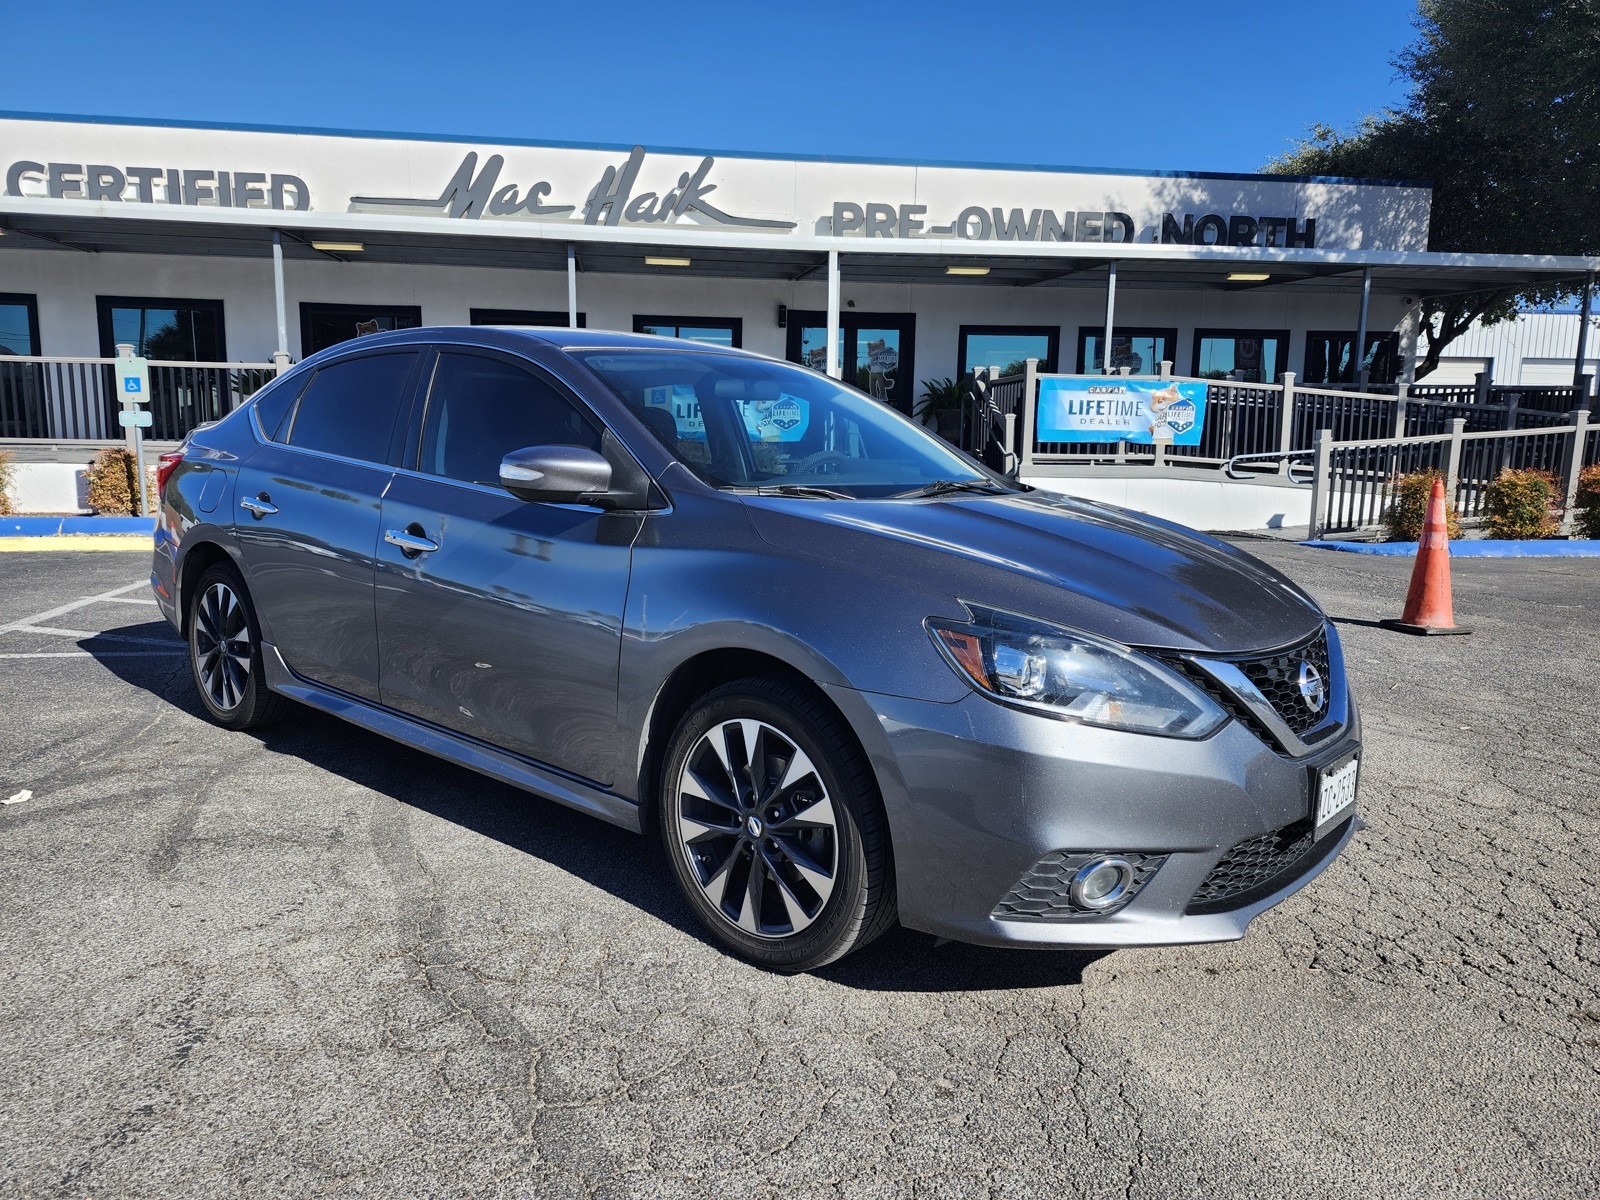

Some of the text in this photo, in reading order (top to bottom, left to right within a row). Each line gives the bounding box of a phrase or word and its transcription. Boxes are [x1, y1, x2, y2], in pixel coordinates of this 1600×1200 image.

[6, 160, 311, 211] CERTIFIED
[440, 145, 735, 227] Mac Haik
[832, 201, 1316, 249] PRE-OWNED NORTH
[1088, 386, 1126, 394] CARFAX
[1068, 399, 1144, 417] LIFETIME
[1080, 418, 1130, 426] DEALER
